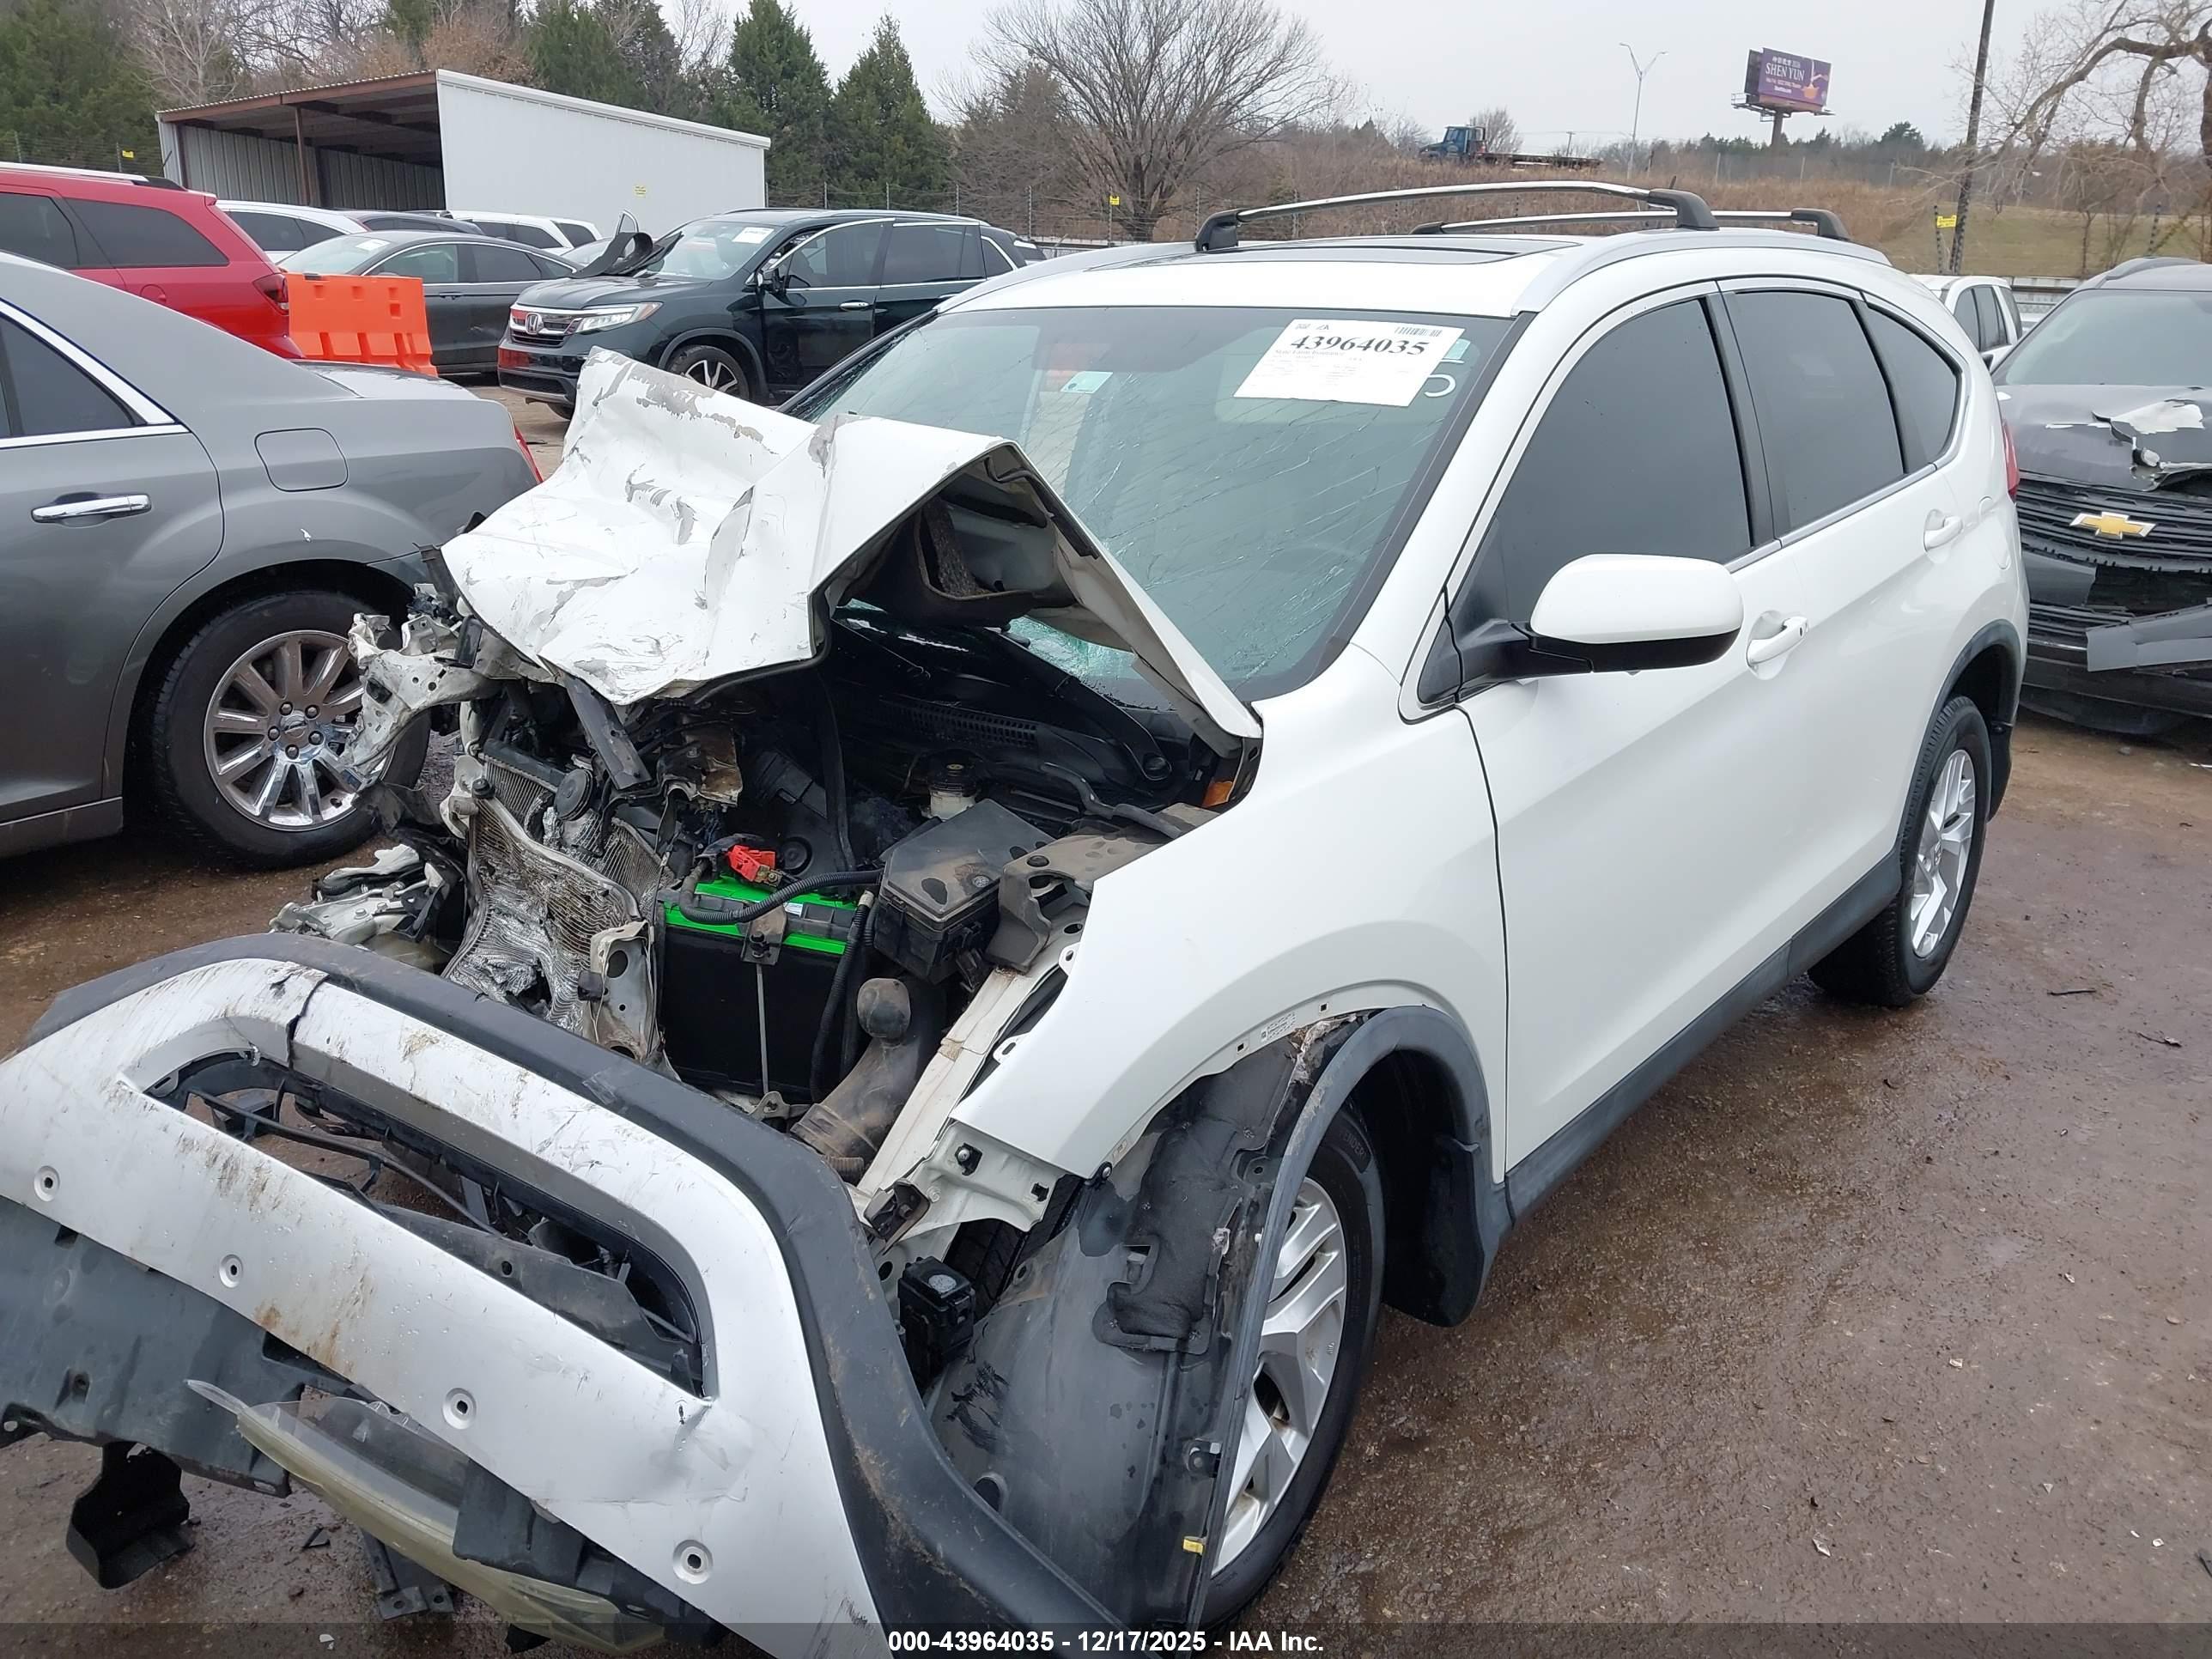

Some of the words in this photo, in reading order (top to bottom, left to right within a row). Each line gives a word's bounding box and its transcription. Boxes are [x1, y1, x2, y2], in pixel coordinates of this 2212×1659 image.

[1765, 63, 1788, 77] SHEN
[1789, 67, 1805, 81] YUN
[1291, 335, 1429, 355] 43964035
